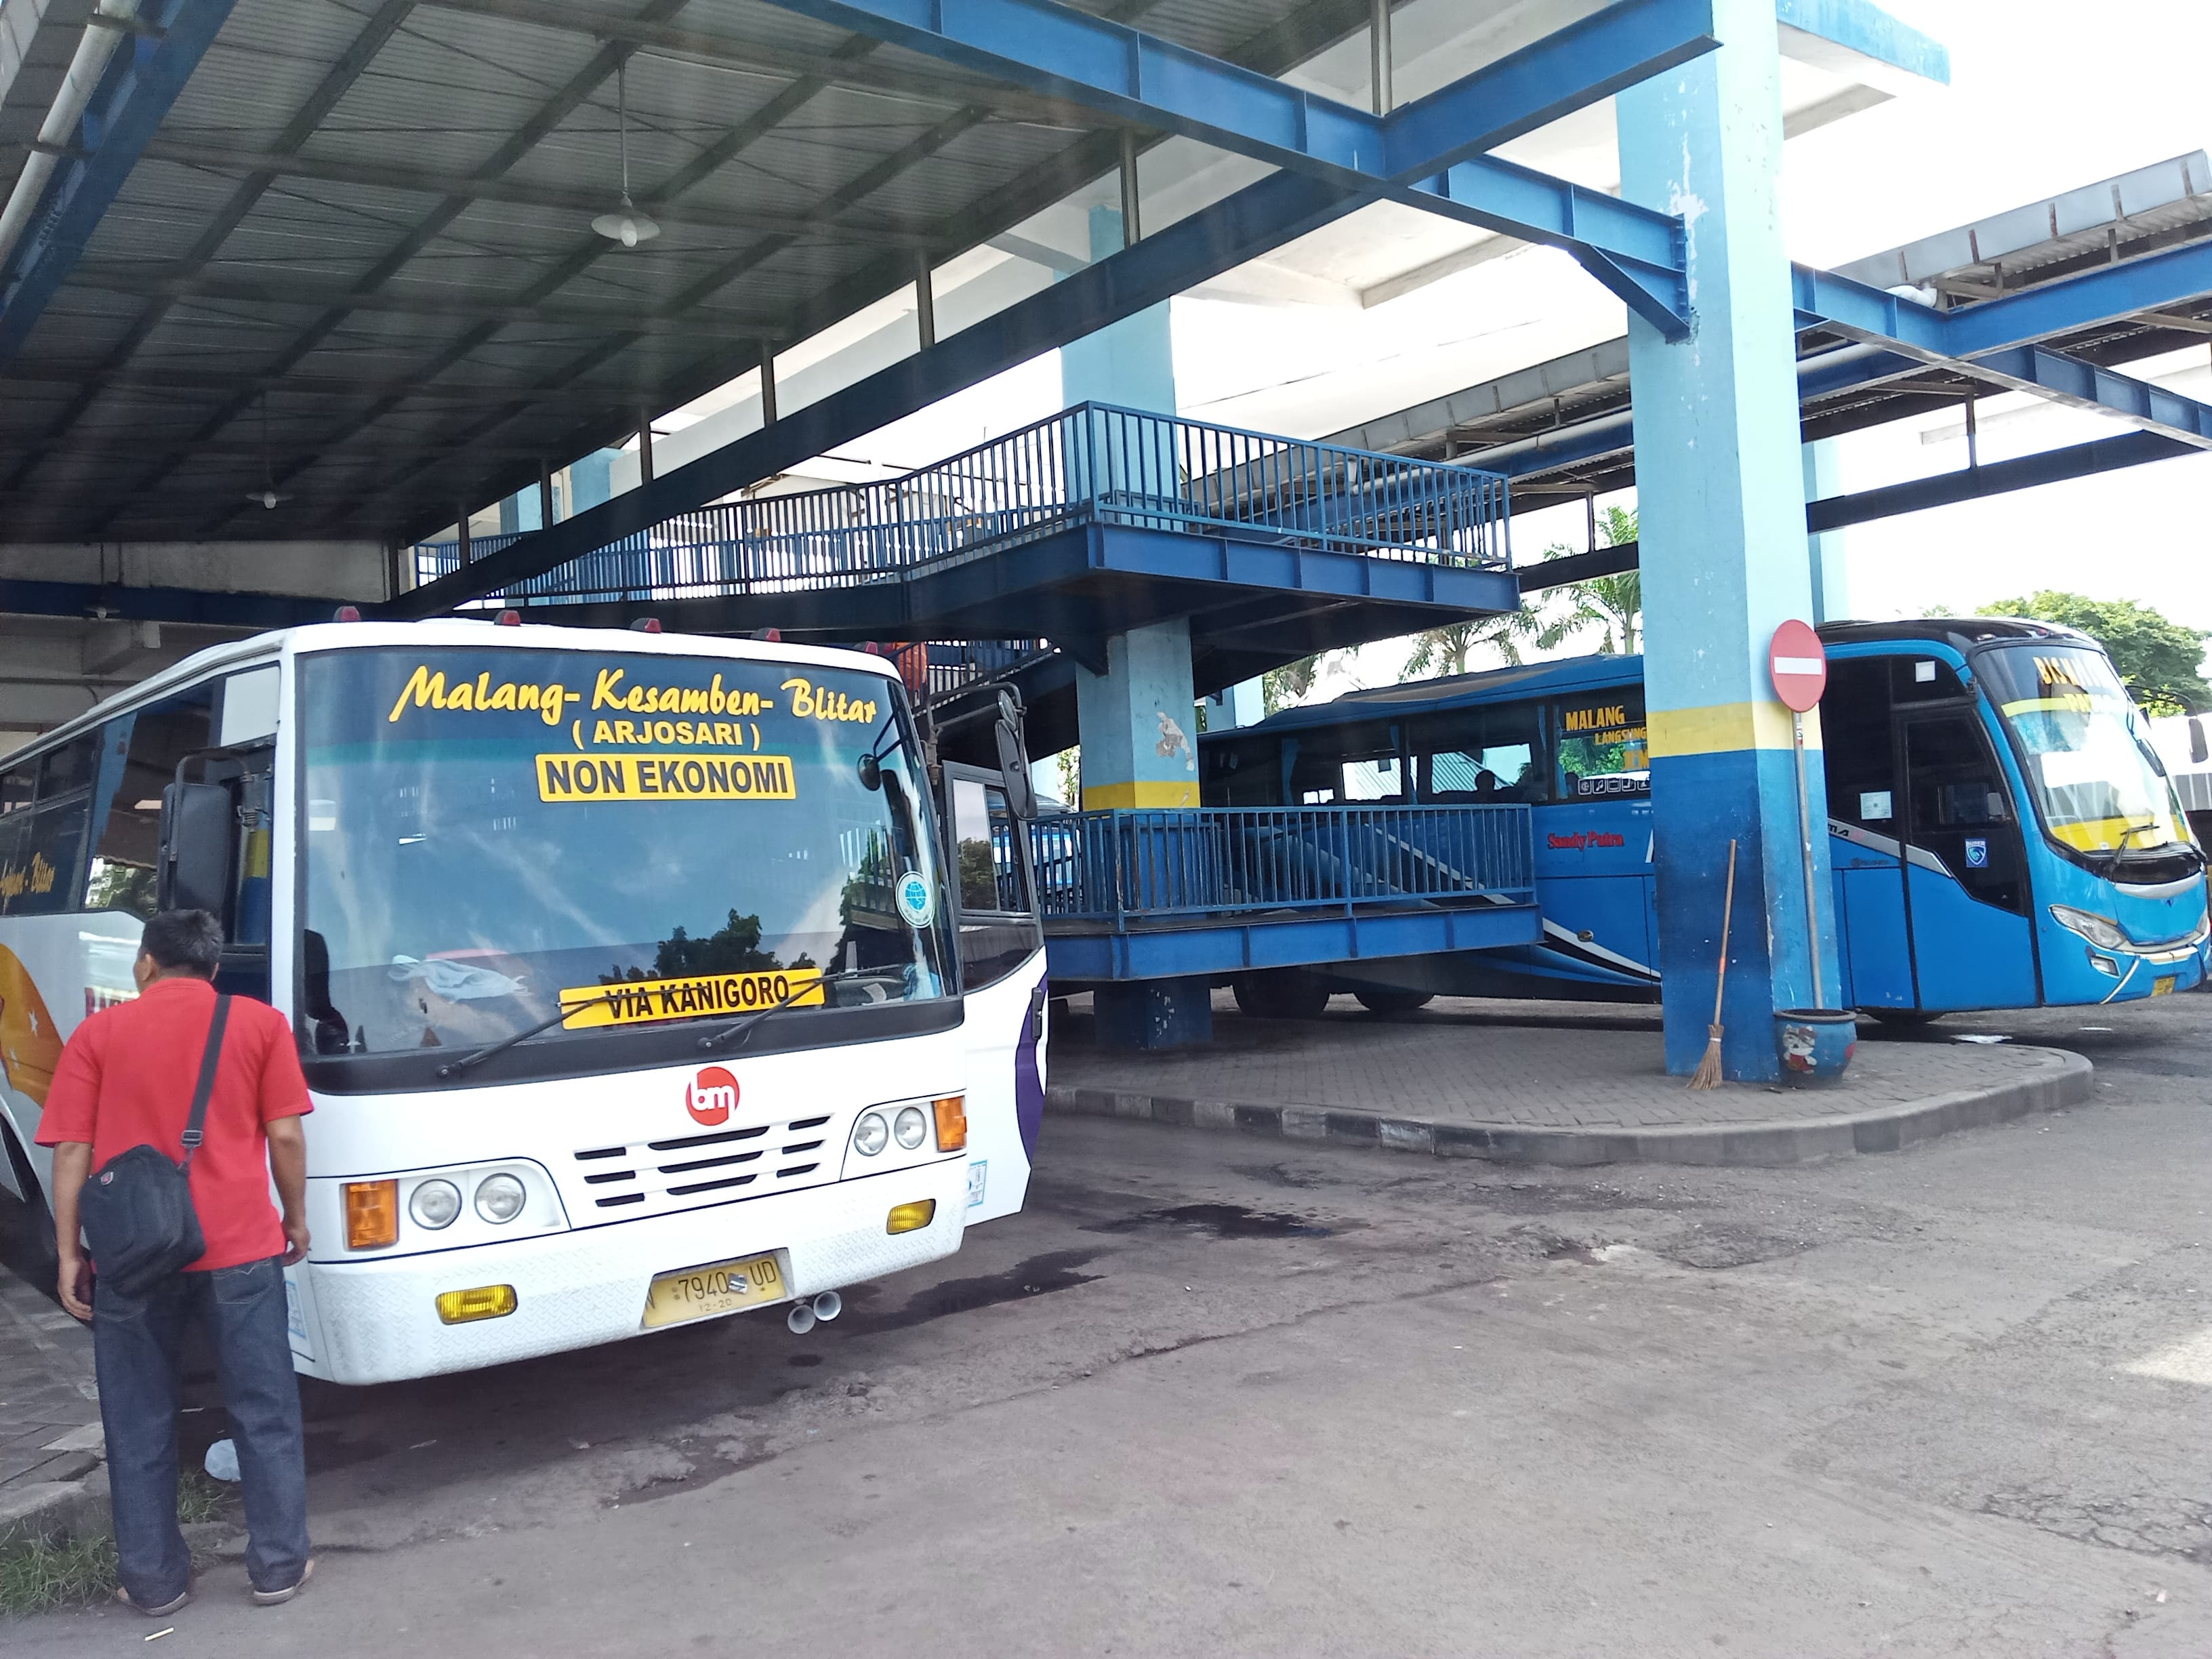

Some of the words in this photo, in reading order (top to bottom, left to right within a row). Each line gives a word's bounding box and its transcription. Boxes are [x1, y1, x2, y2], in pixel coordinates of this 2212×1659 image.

[780, 678, 878, 724] Blitar
[1565, 705, 1626, 732] MALANG
[545, 760, 626, 794] NON
[636, 760, 788, 794] EKONOMI
[605, 987, 653, 1019] VIA
[660, 975, 790, 1015] KANIGORO
[678, 1271, 730, 1303] 7940
[749, 1261, 777, 1286] UD
